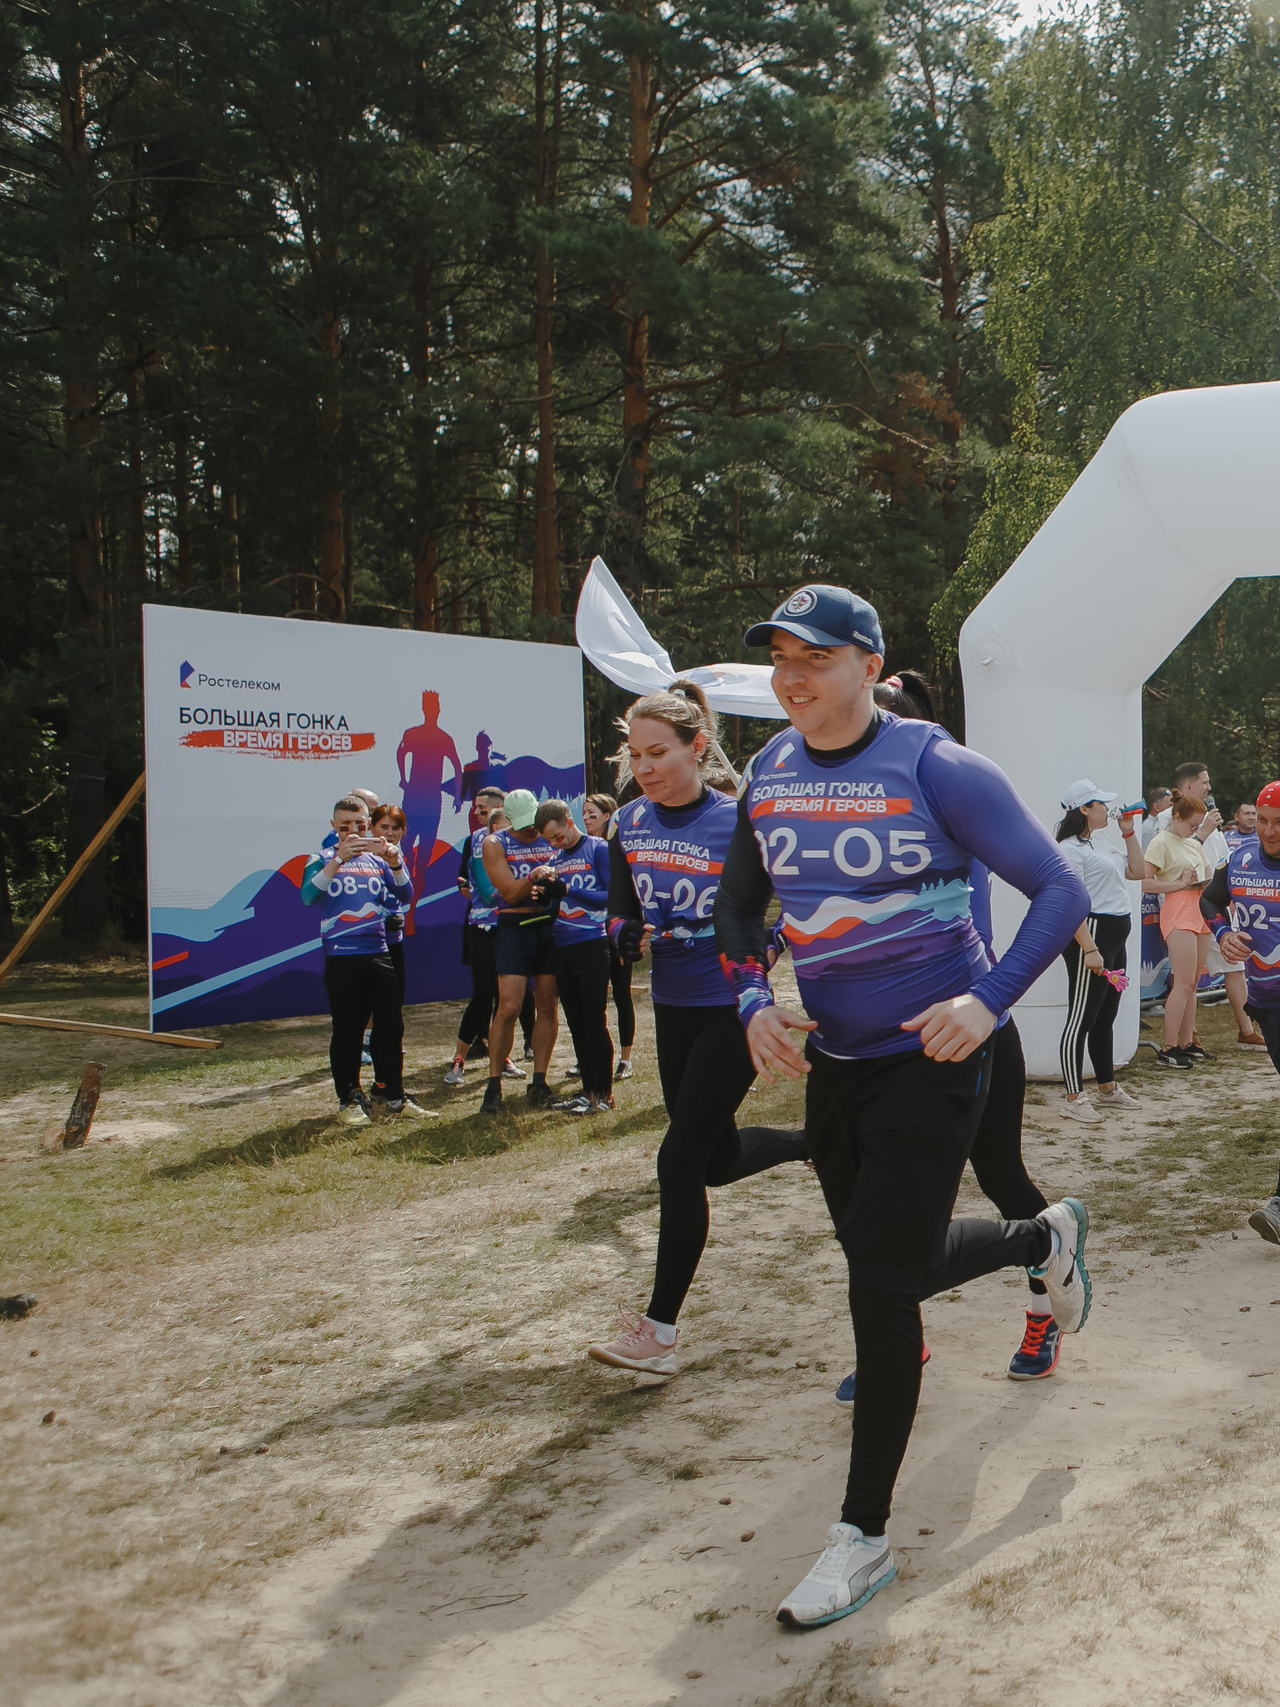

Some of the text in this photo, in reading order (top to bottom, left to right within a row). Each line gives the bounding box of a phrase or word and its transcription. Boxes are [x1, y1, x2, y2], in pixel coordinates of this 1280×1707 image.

[198, 673, 281, 691] Ростелеком
[179, 706, 350, 731] БОЛЬШАЯ ГОНКА
[222, 730, 352, 751] ВРЕМЯ ГЕРОЕВ
[752, 782, 887, 802] БОЛЬШАЯ ГОНКА
[773, 799, 888, 813] ВРЕМЯ ГЕРОЕВ
[621, 838, 710, 860] БОЛЬШАЯ ГОНКА
[636, 851, 710, 872] ВРЕМЯ ГЕРОЕВ
[1230, 876, 1274, 888] БОЛЬШАЯ
[1245, 887, 1274, 897] ВРЕМЯ
[632, 872, 718, 919] 2-06
